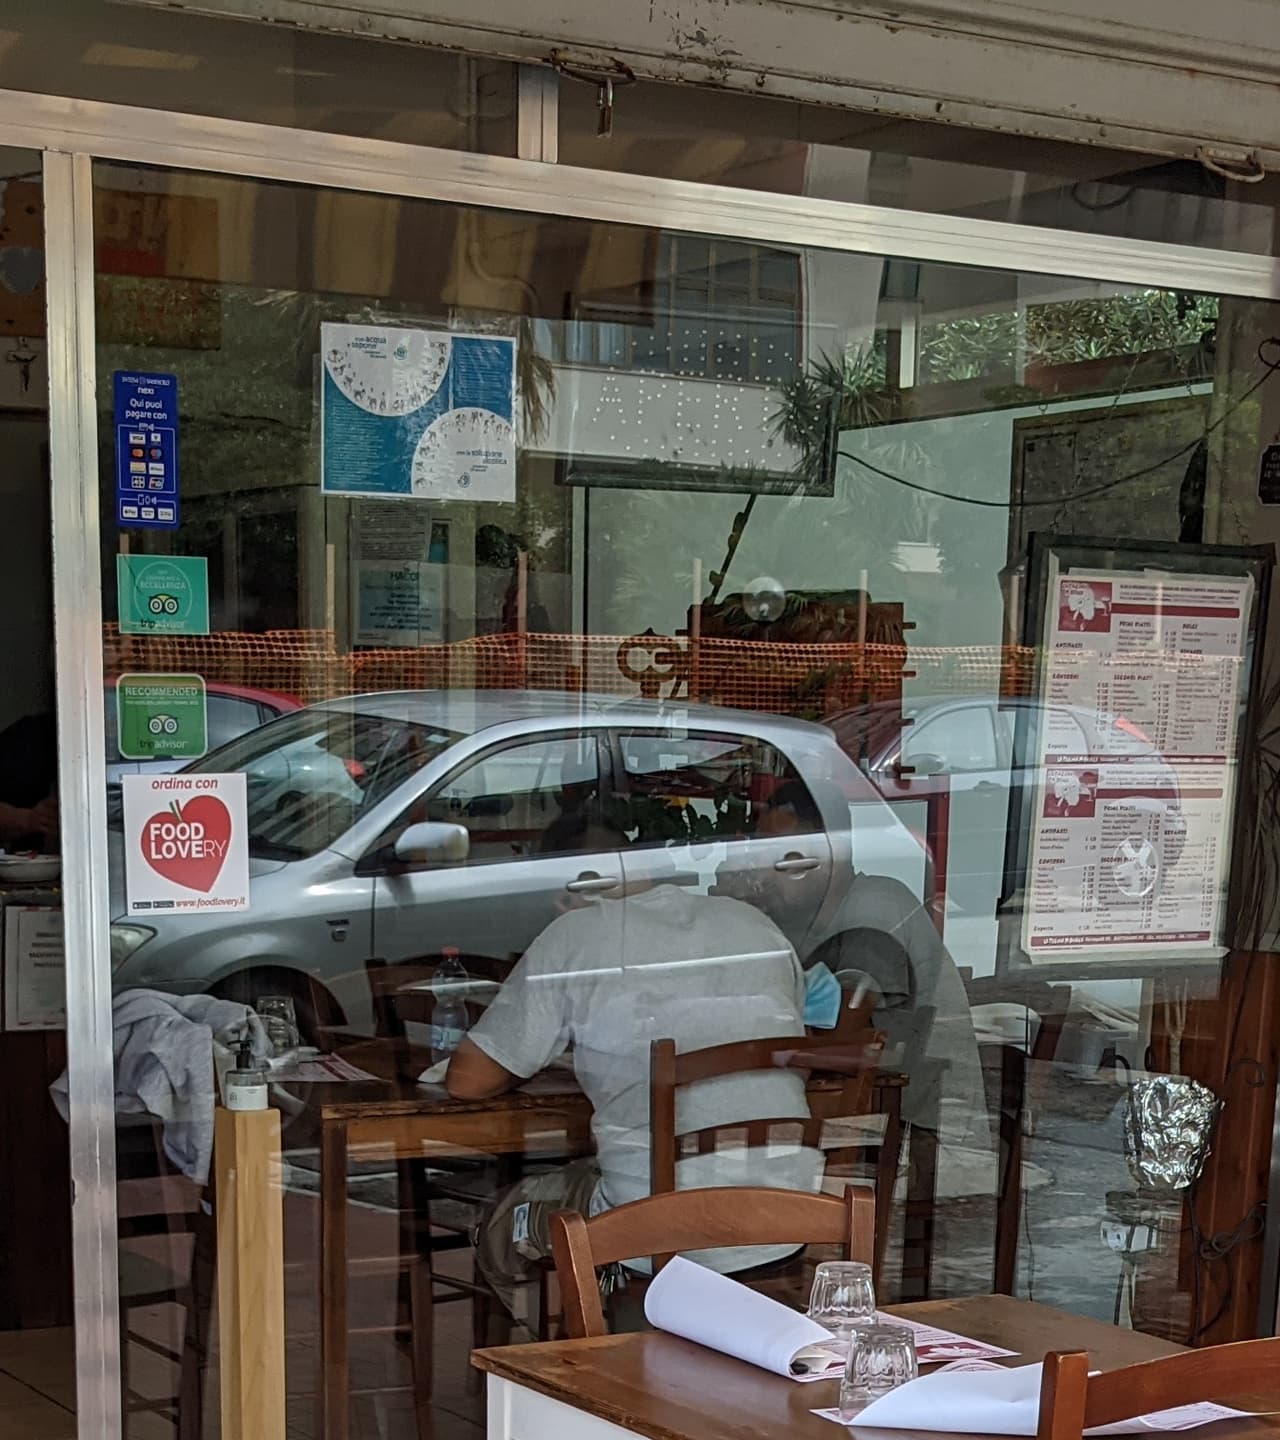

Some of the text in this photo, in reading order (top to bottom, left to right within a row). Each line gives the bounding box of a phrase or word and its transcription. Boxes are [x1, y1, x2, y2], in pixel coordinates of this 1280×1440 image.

[130, 398, 163, 410] Qui puoi
[125, 410, 167, 420] pagare con
[125, 687, 198, 696] RECOMMENDED
[152, 778, 218, 790] ordina con
[150, 822, 204, 841] FOOD
[150, 839, 227, 860] LOVERY
[176, 896, 245, 908] www.foodlovery.it
